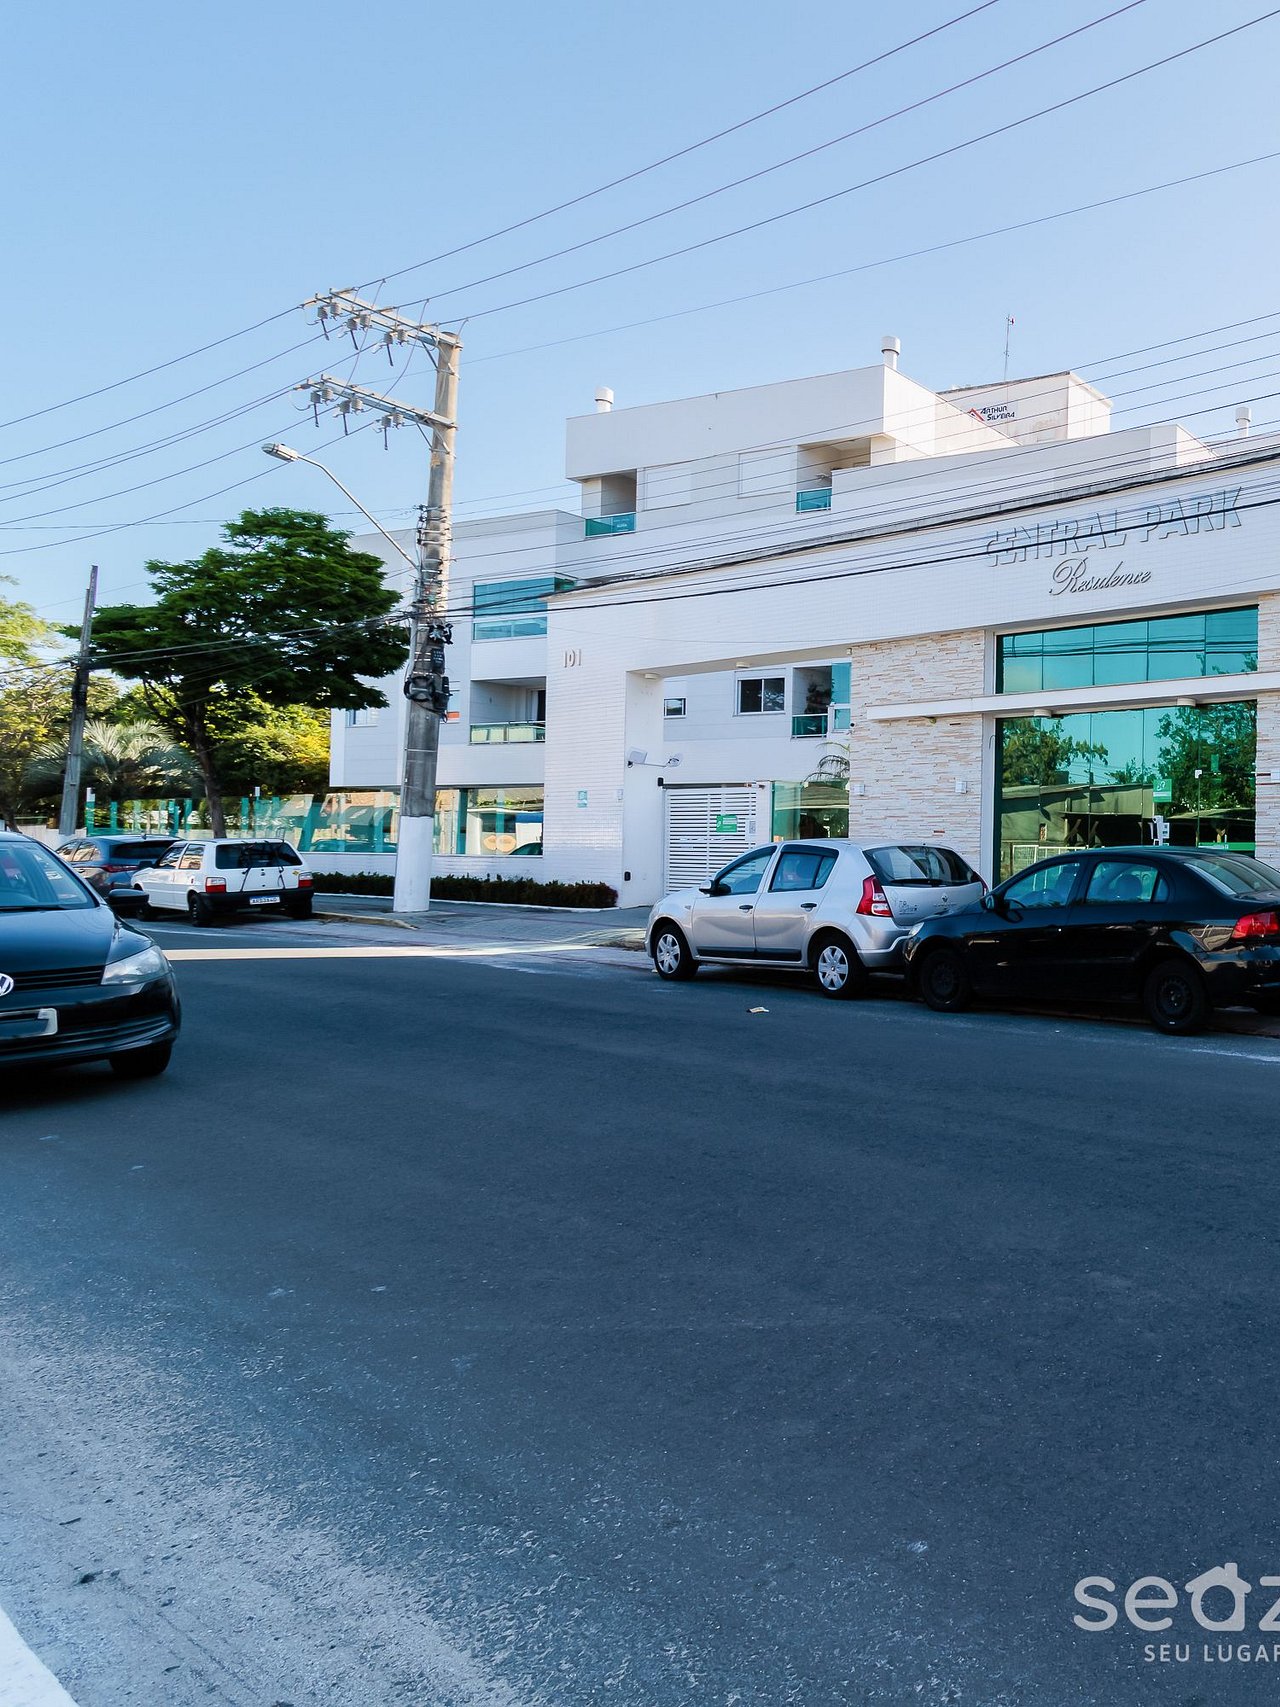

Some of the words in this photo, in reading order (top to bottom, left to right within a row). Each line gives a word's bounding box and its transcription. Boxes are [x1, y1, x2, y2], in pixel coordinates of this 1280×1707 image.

[1140, 487, 1242, 543] PARK
[1048, 556, 1152, 595] Residence
[563, 649, 582, 668] 101
